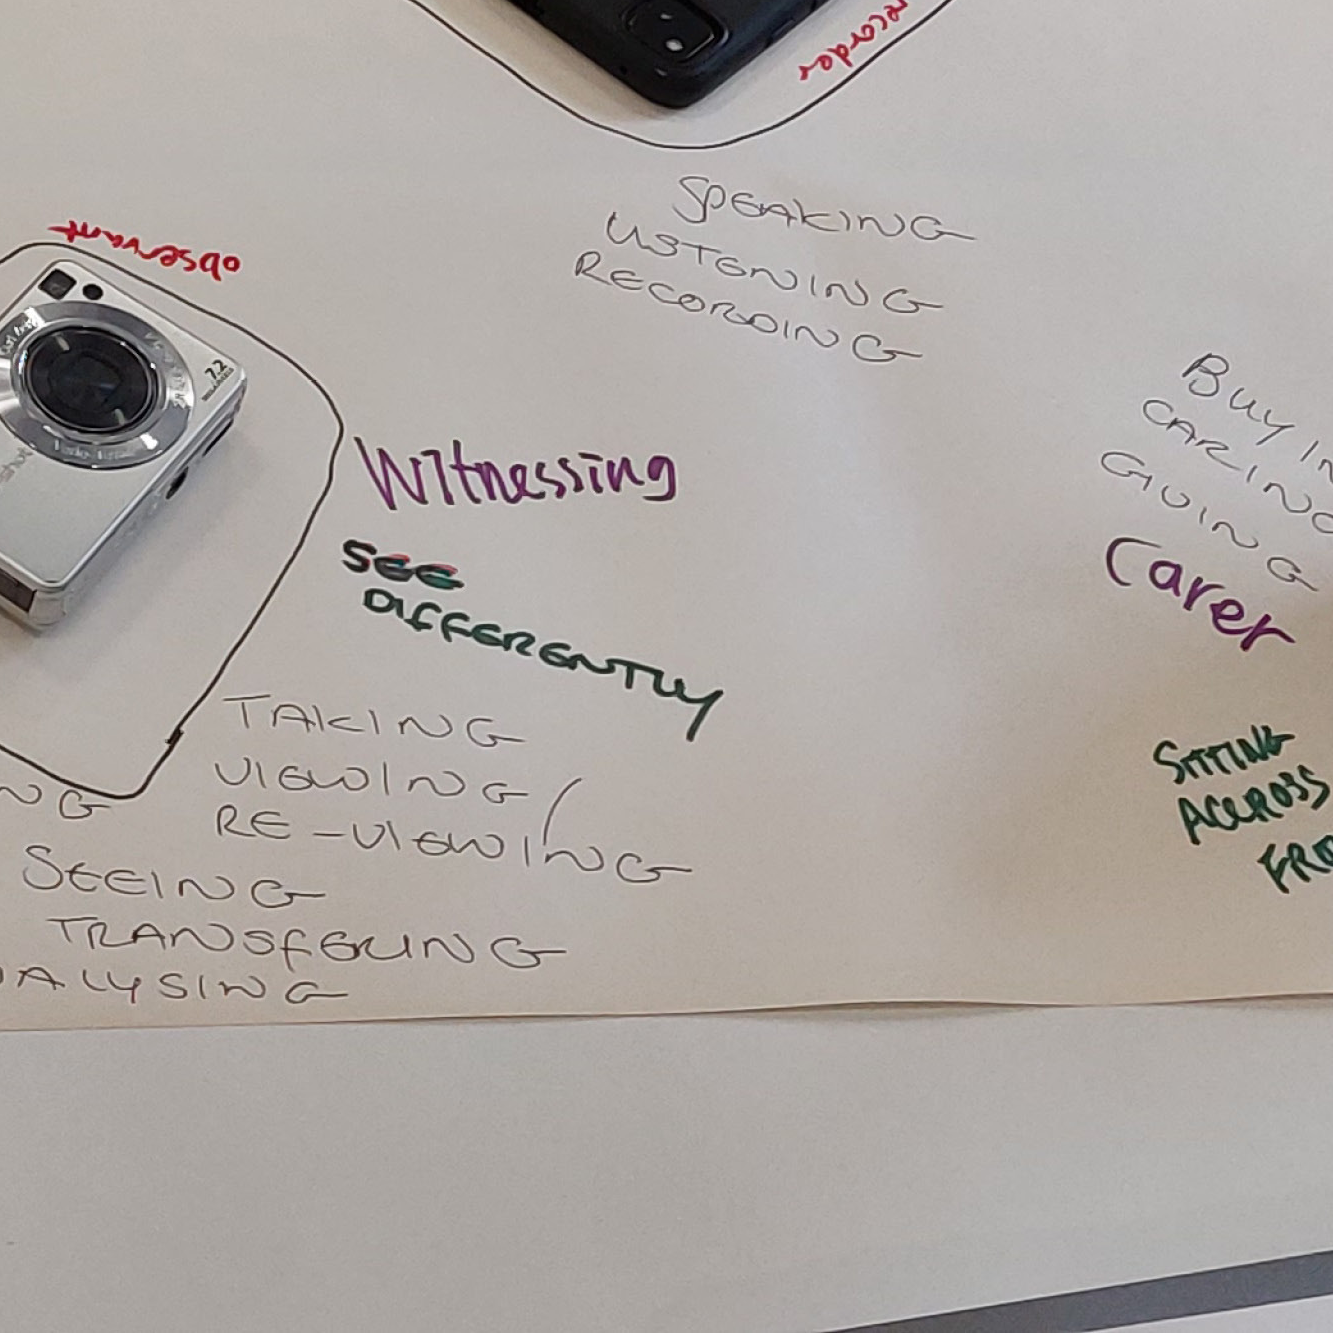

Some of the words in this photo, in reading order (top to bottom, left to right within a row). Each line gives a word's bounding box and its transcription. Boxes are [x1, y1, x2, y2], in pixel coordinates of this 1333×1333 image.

[673, 176, 976, 241] SPEAKING
[574, 251, 923, 363] RECORDING
[202, 358, 228, 381] 7.2
[342, 539, 464, 589] SEE
[1106, 536, 1296, 652] Carer
[223, 694, 527, 747] TAKING
[22, 845, 327, 909] SEEING
